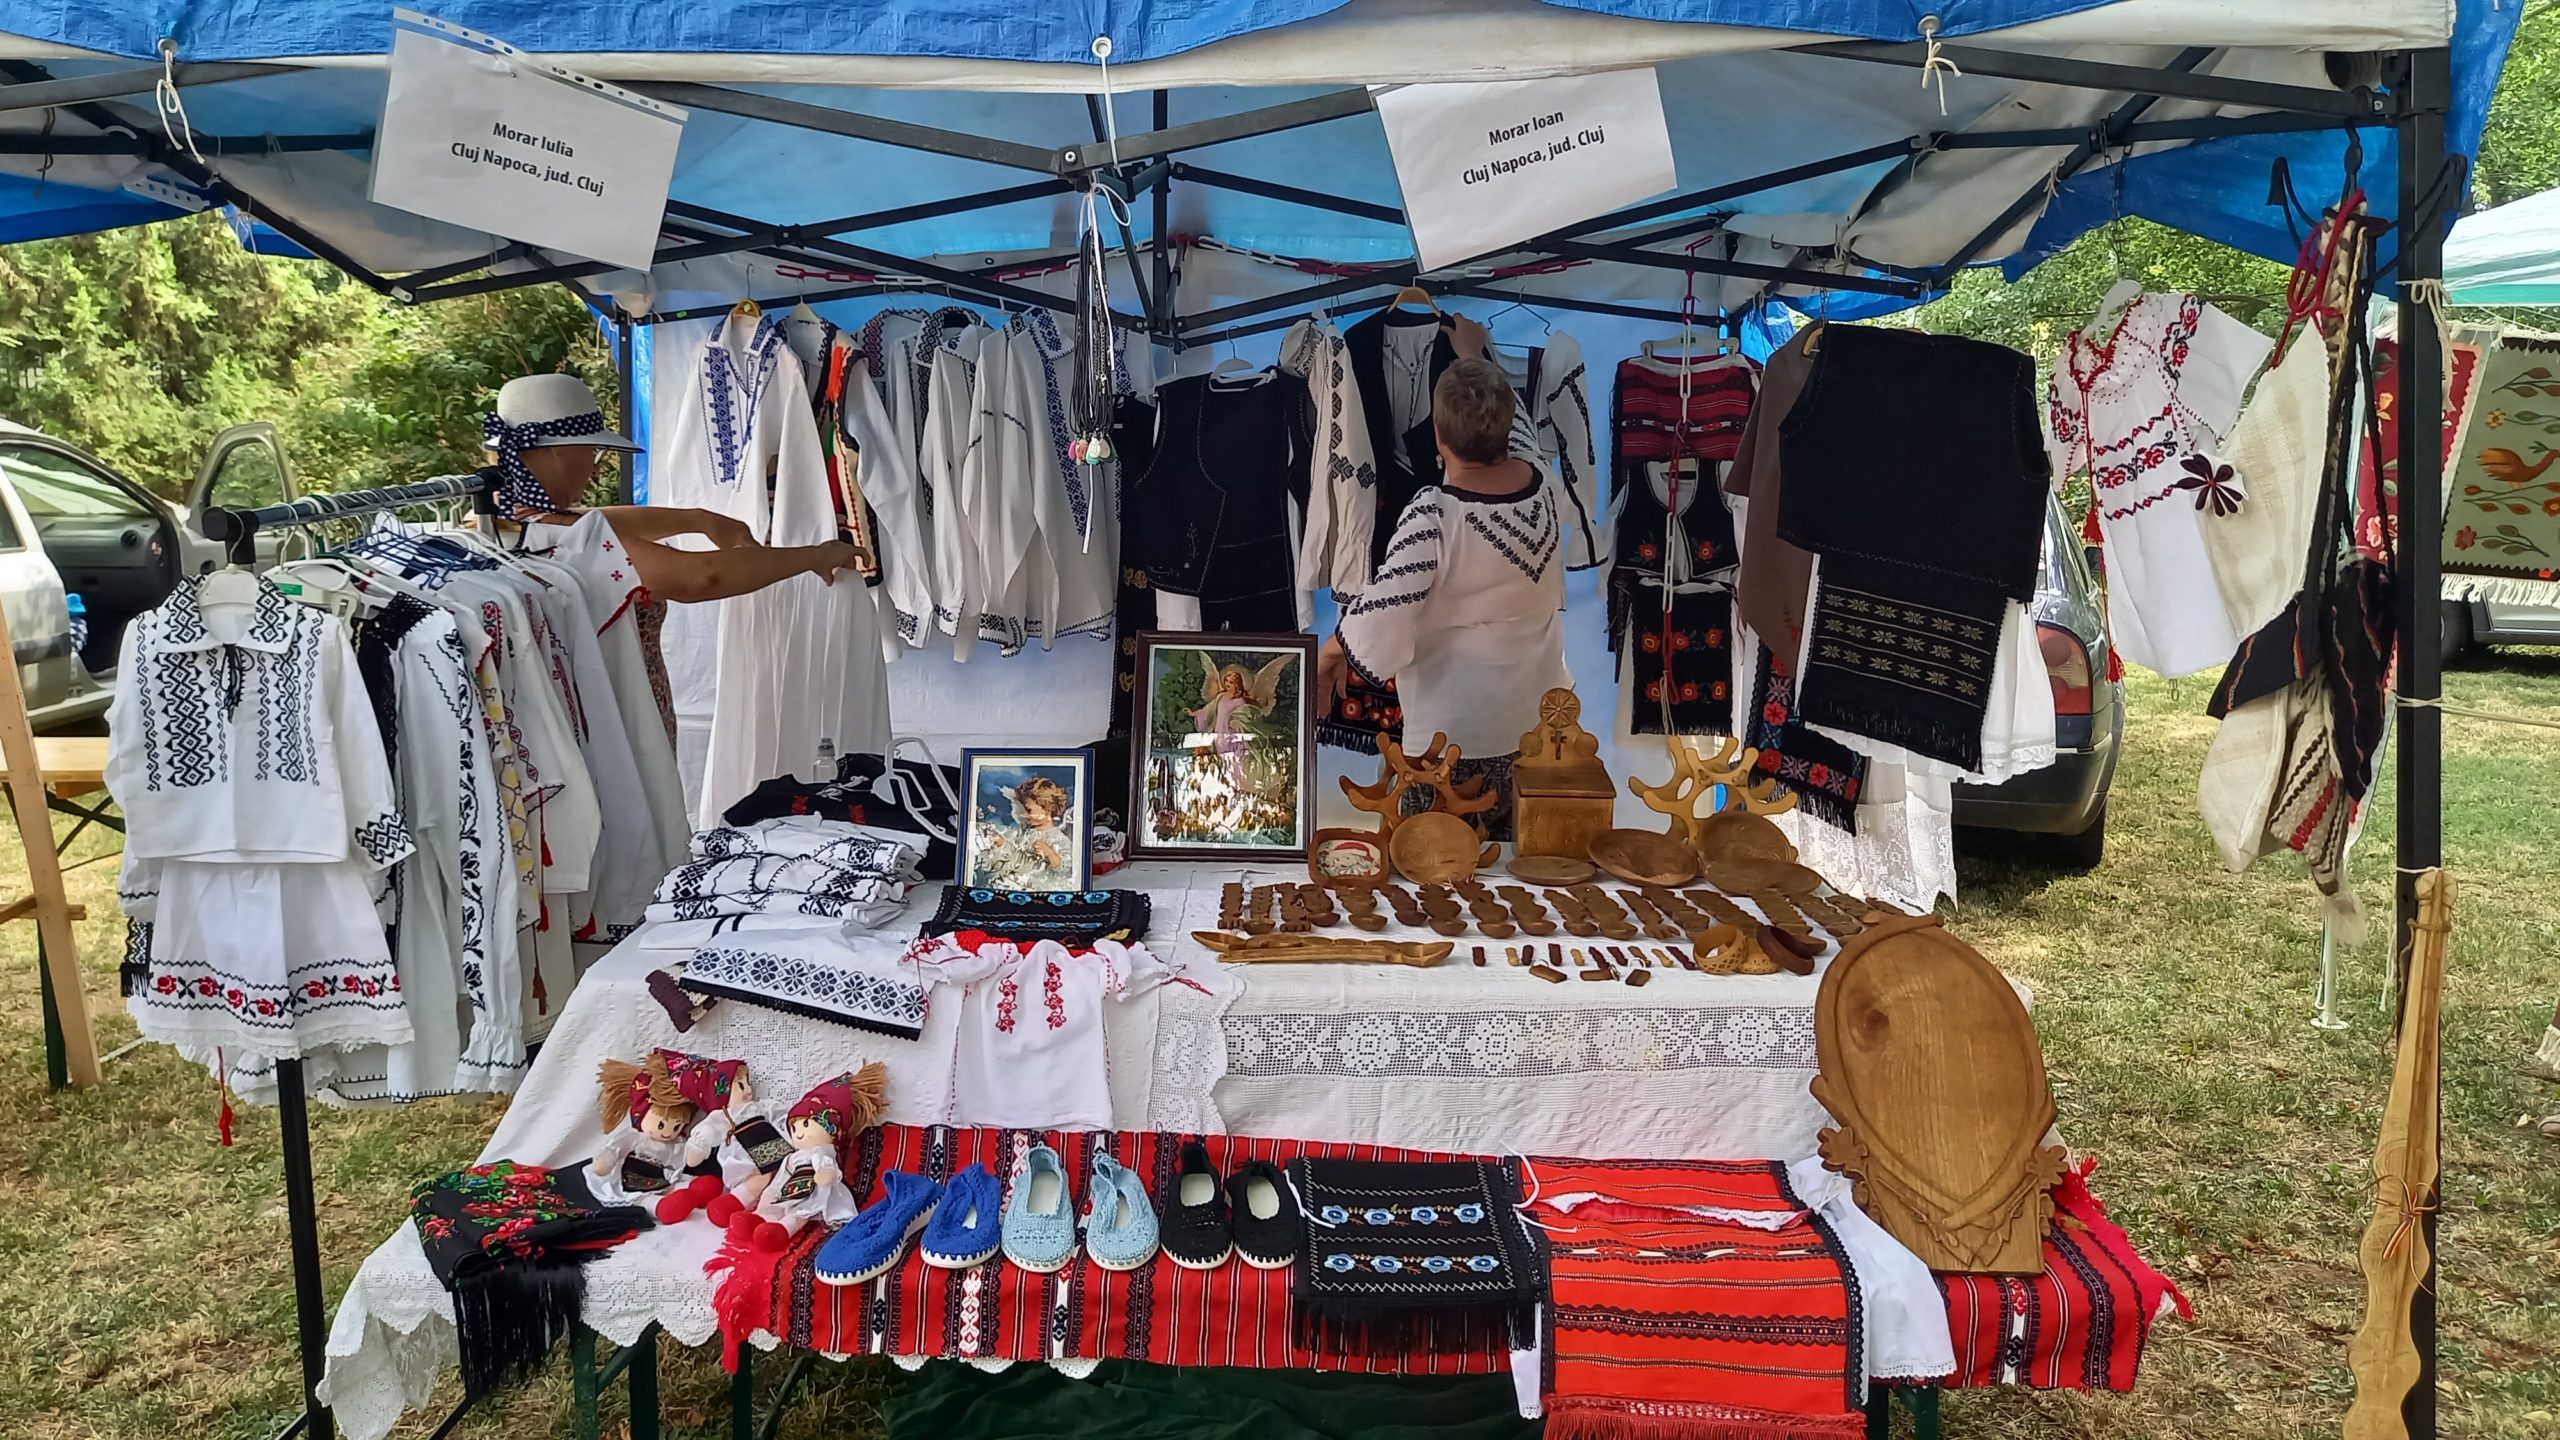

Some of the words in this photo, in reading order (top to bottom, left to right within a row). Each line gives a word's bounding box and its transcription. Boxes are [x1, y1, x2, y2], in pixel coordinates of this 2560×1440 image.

[492, 122, 538, 146] Morar
[540, 136, 574, 158] Iulia
[1488, 122, 1530, 146] Morar
[1532, 111, 1564, 131] Ioan
[451, 142, 480, 164] Cluj
[482, 149, 542, 178] Napoca,
[543, 165, 573, 186] jud.
[576, 176, 604, 197] Cluj
[1463, 165, 1490, 185] Cluj
[1490, 150, 1547, 176] Napoca,
[1547, 136, 1576, 161] jud.
[1577, 125, 1605, 146] Cluj
